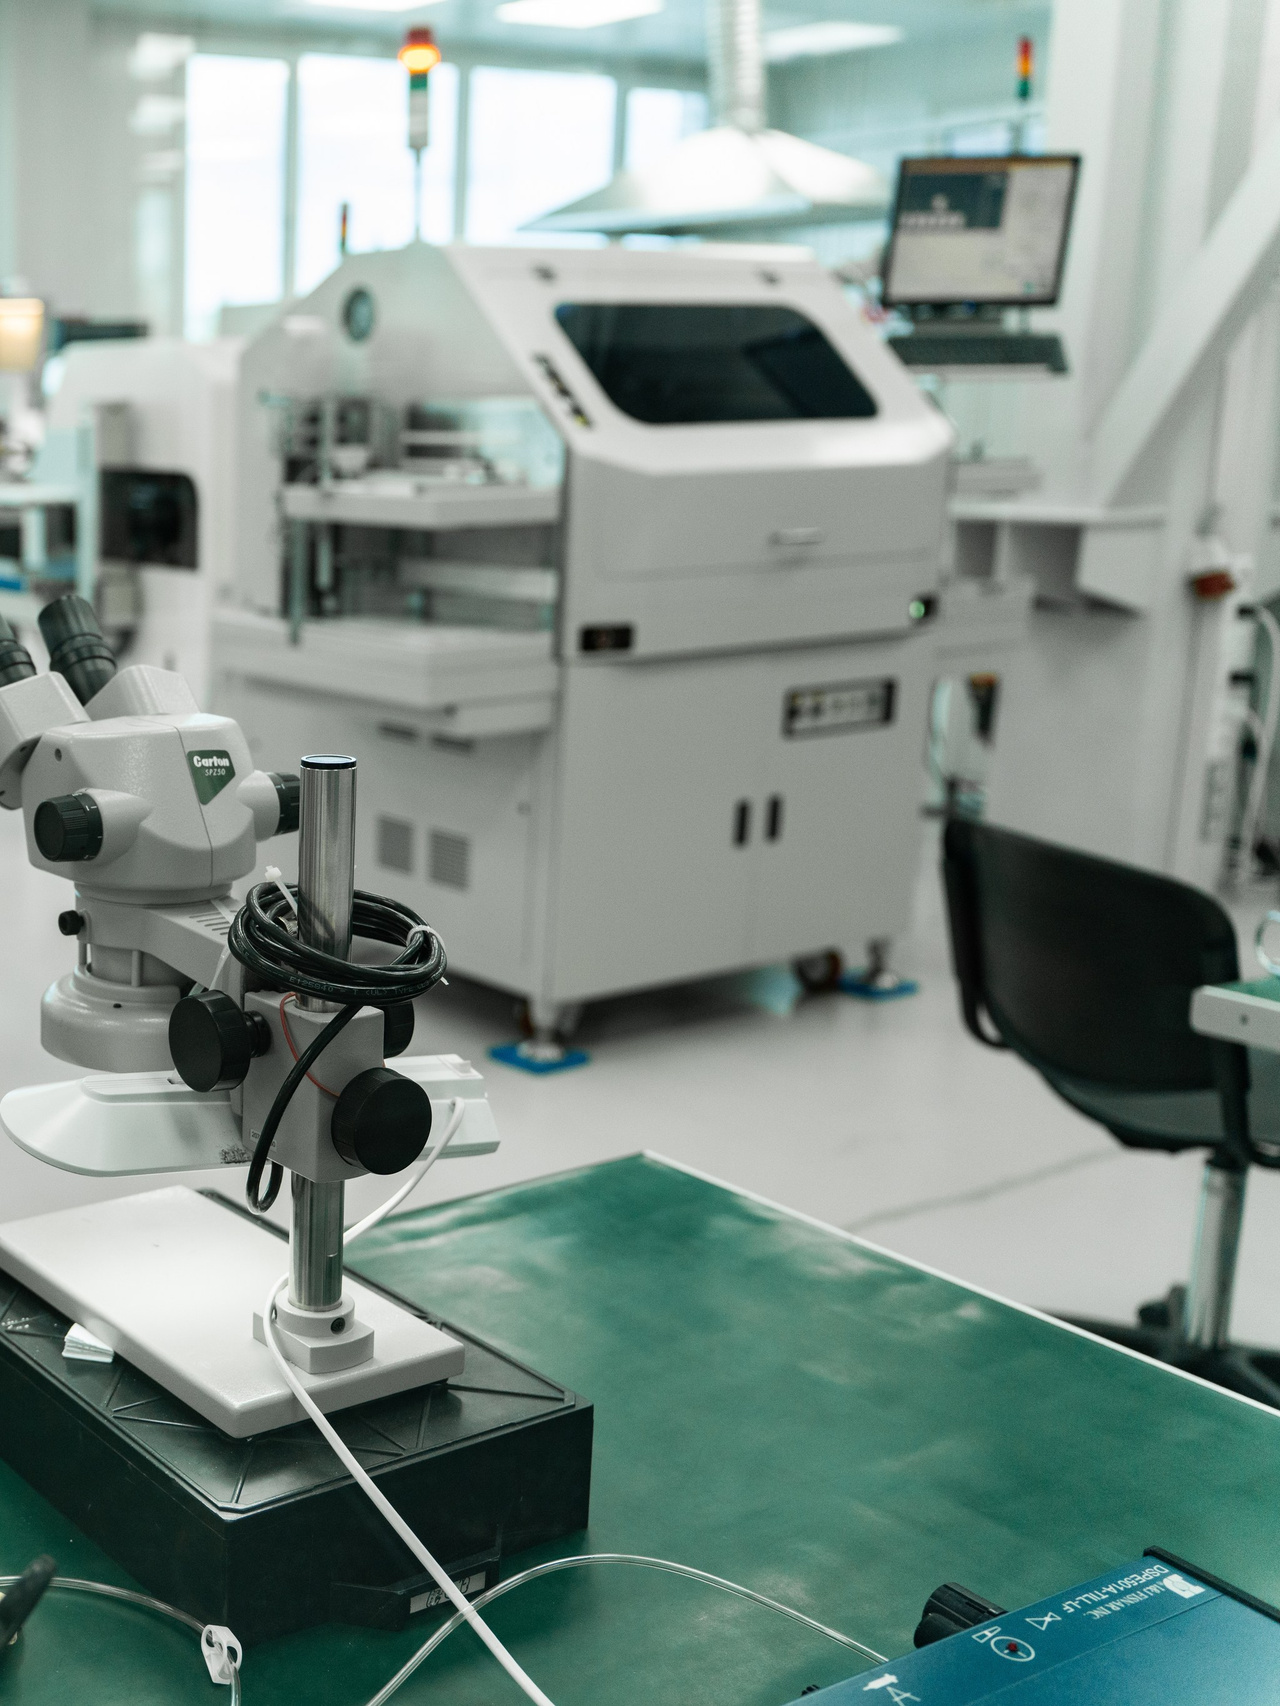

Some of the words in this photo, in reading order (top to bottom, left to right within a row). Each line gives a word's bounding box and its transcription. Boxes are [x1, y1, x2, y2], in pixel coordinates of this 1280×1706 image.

[193, 755, 230, 767] Carton
[204, 768, 226, 776] SPZ50
[1062, 1564, 1170, 1613] DSPE501A-TILL-LF
[1105, 1591, 1149, 1612] FISNAR
[1083, 1606, 1112, 1620] INC.
